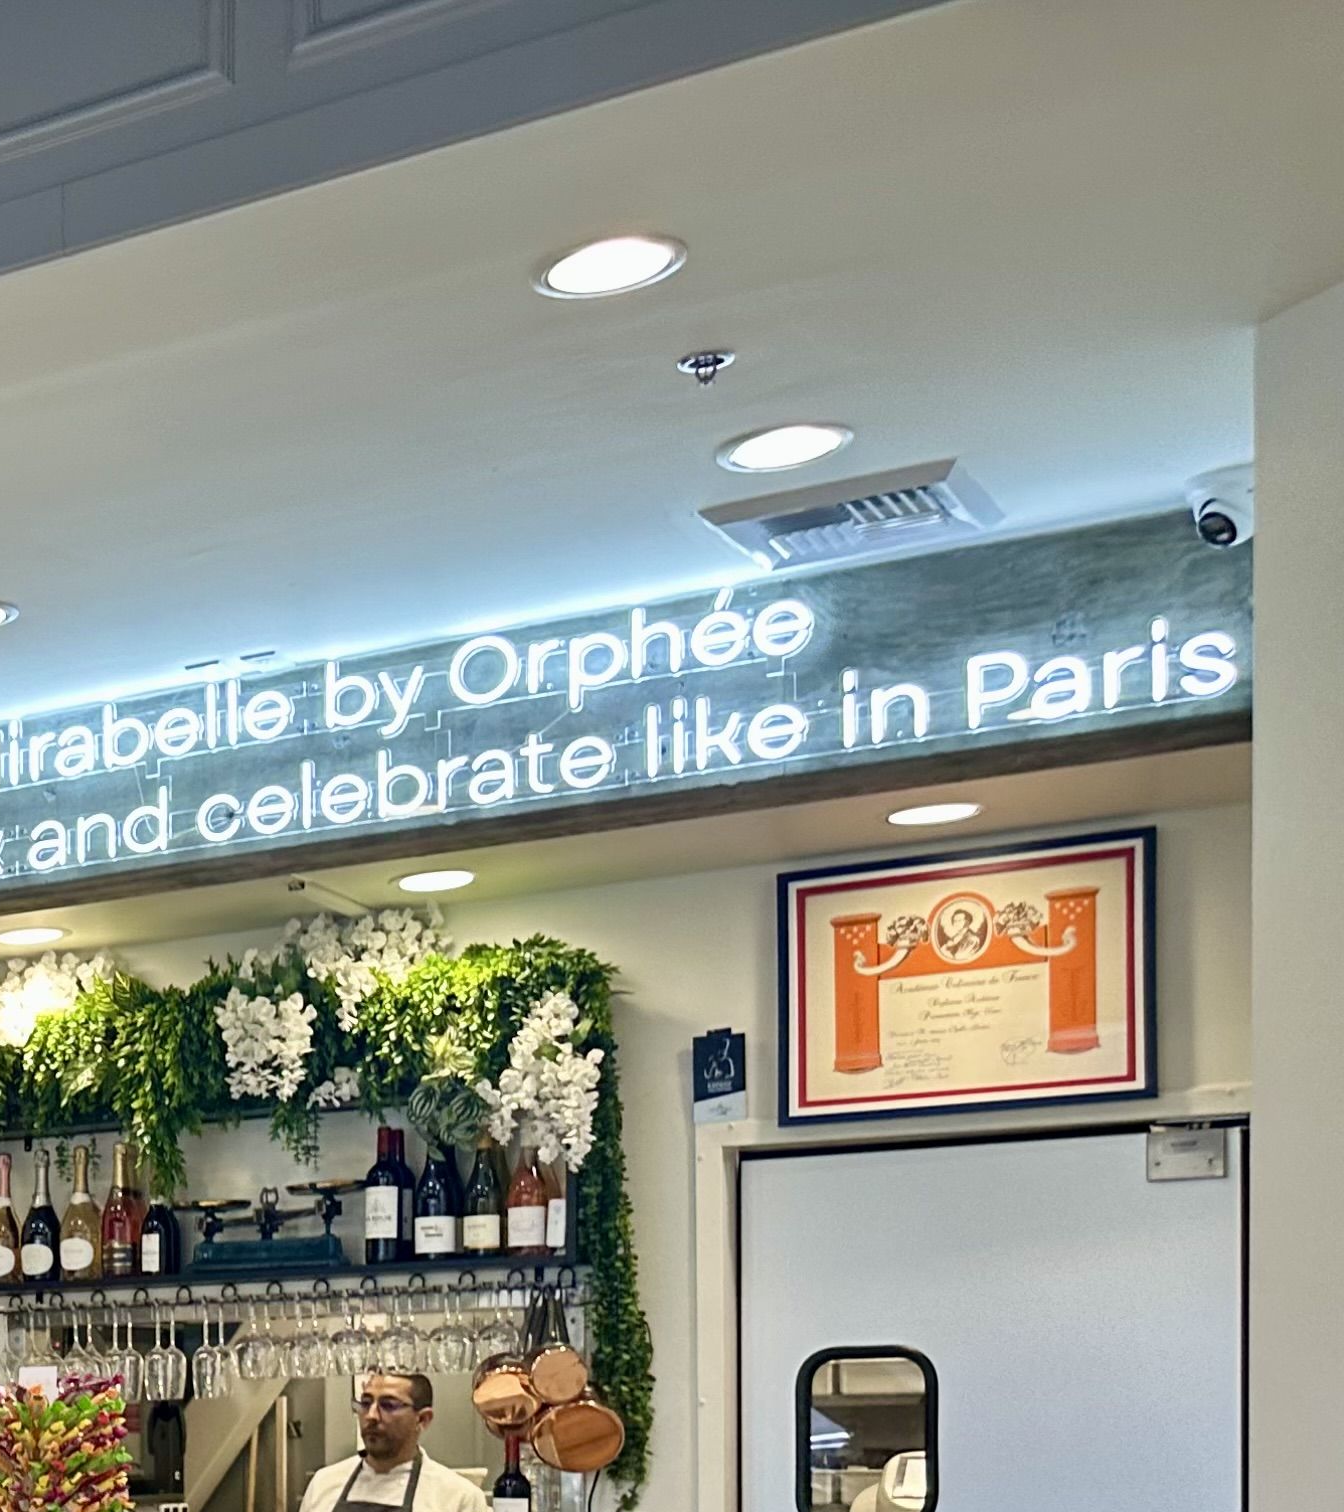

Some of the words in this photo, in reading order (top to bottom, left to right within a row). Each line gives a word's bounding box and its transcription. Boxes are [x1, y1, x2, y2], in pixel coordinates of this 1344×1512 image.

[26, 786, 169, 873] and
[195, 732, 617, 844] celebrate
[647, 696, 810, 780] like
[842, 666, 930, 750] in
[965, 616, 1238, 731] Paris
[324, 660, 425, 738] by
[449, 587, 814, 712] Orphée
